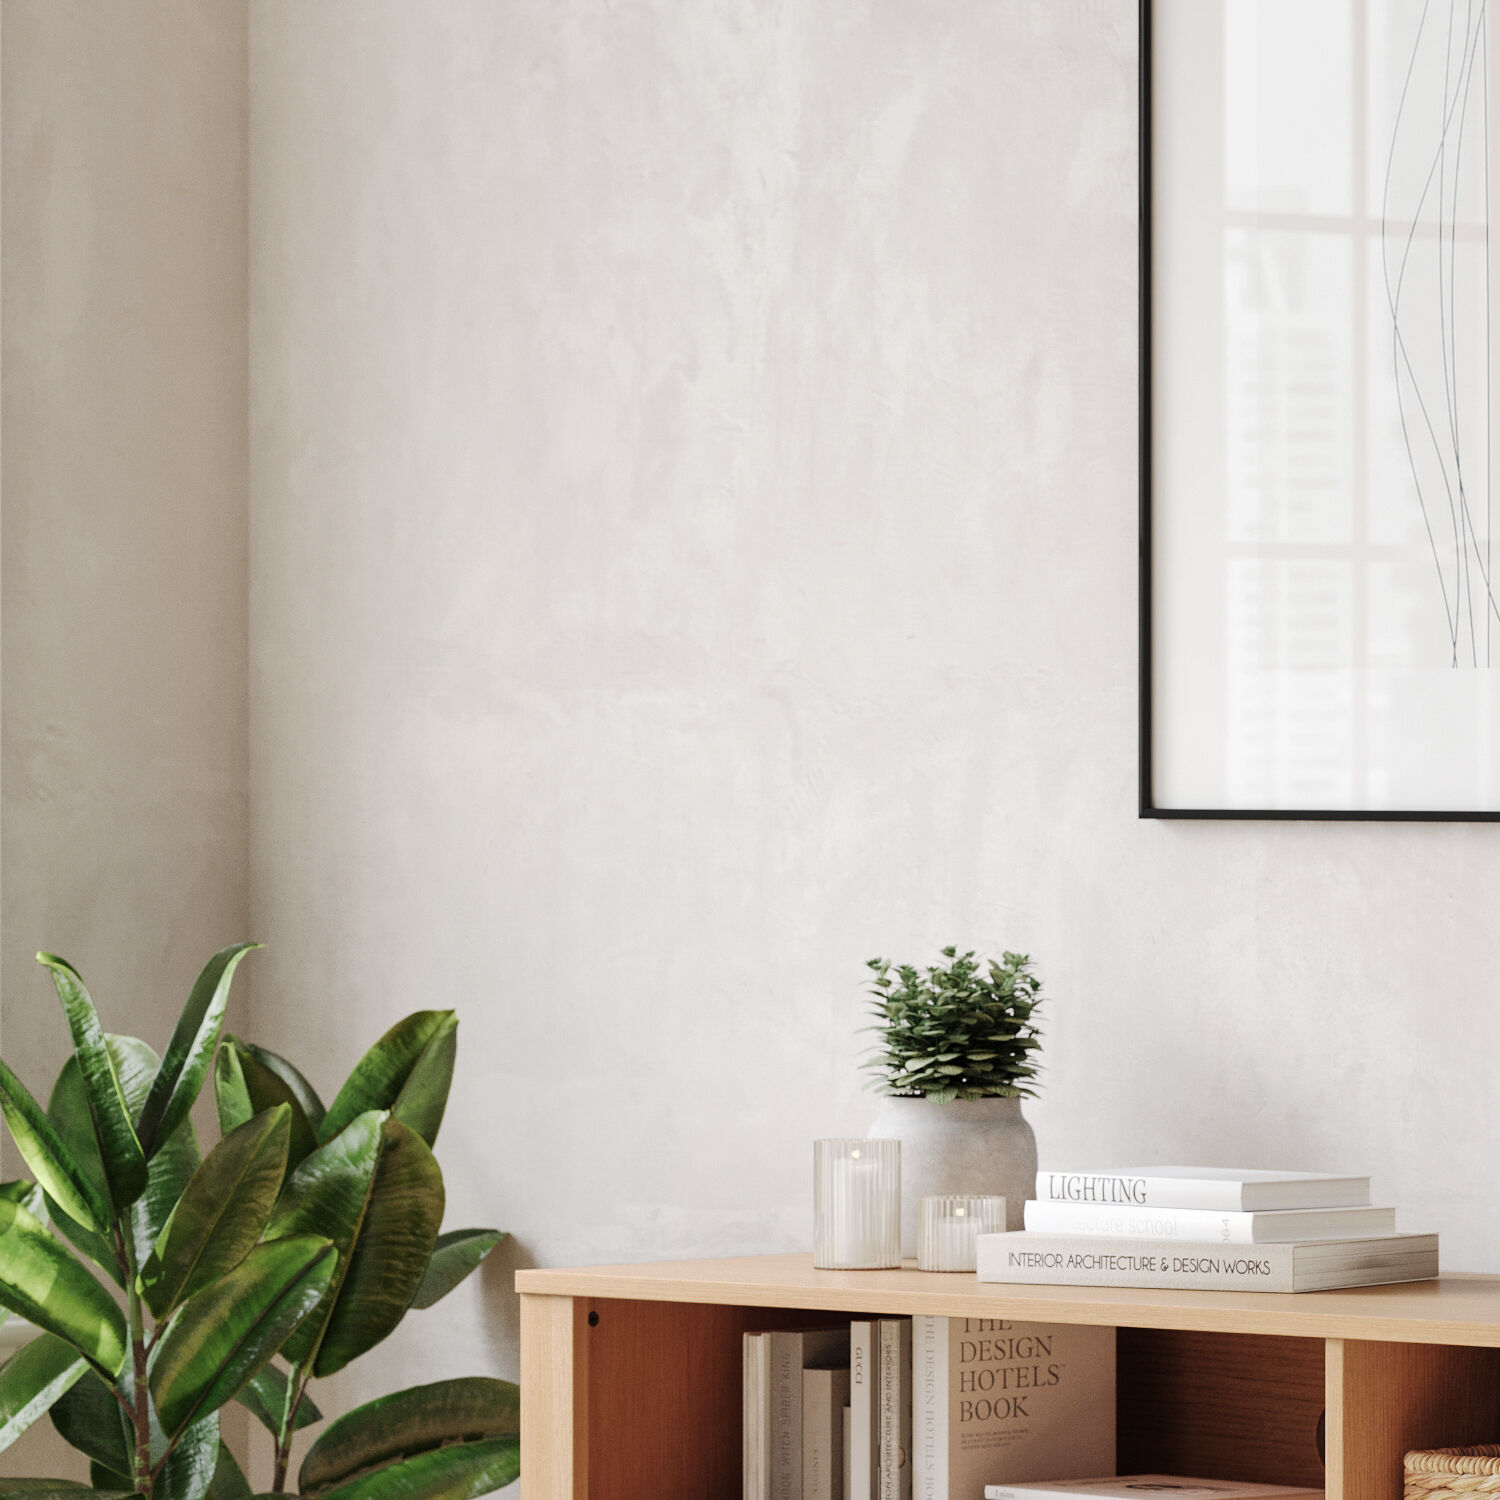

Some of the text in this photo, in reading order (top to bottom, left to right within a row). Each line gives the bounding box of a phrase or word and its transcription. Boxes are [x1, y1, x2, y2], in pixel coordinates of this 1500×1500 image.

[1049, 1175, 1147, 1204] LIGHTING
[1128, 1213, 1179, 1237] school
[1008, 1252, 1271, 1276] INTERIOR ARCHITECTURE & DESIGN WORKS
[960, 1335, 1053, 1363] DESIGN
[855, 1346, 864, 1385] GUCCI
[884, 1344, 893, 1391] INTERIORS
[925, 1350, 935, 1405] DESIGN
[884, 1392, 893, 1413] AND
[960, 1395, 1030, 1422] BOOK
[884, 1415, 893, 1479] ARCHITECTURE
[925, 1411, 935, 1471] HOTELS
